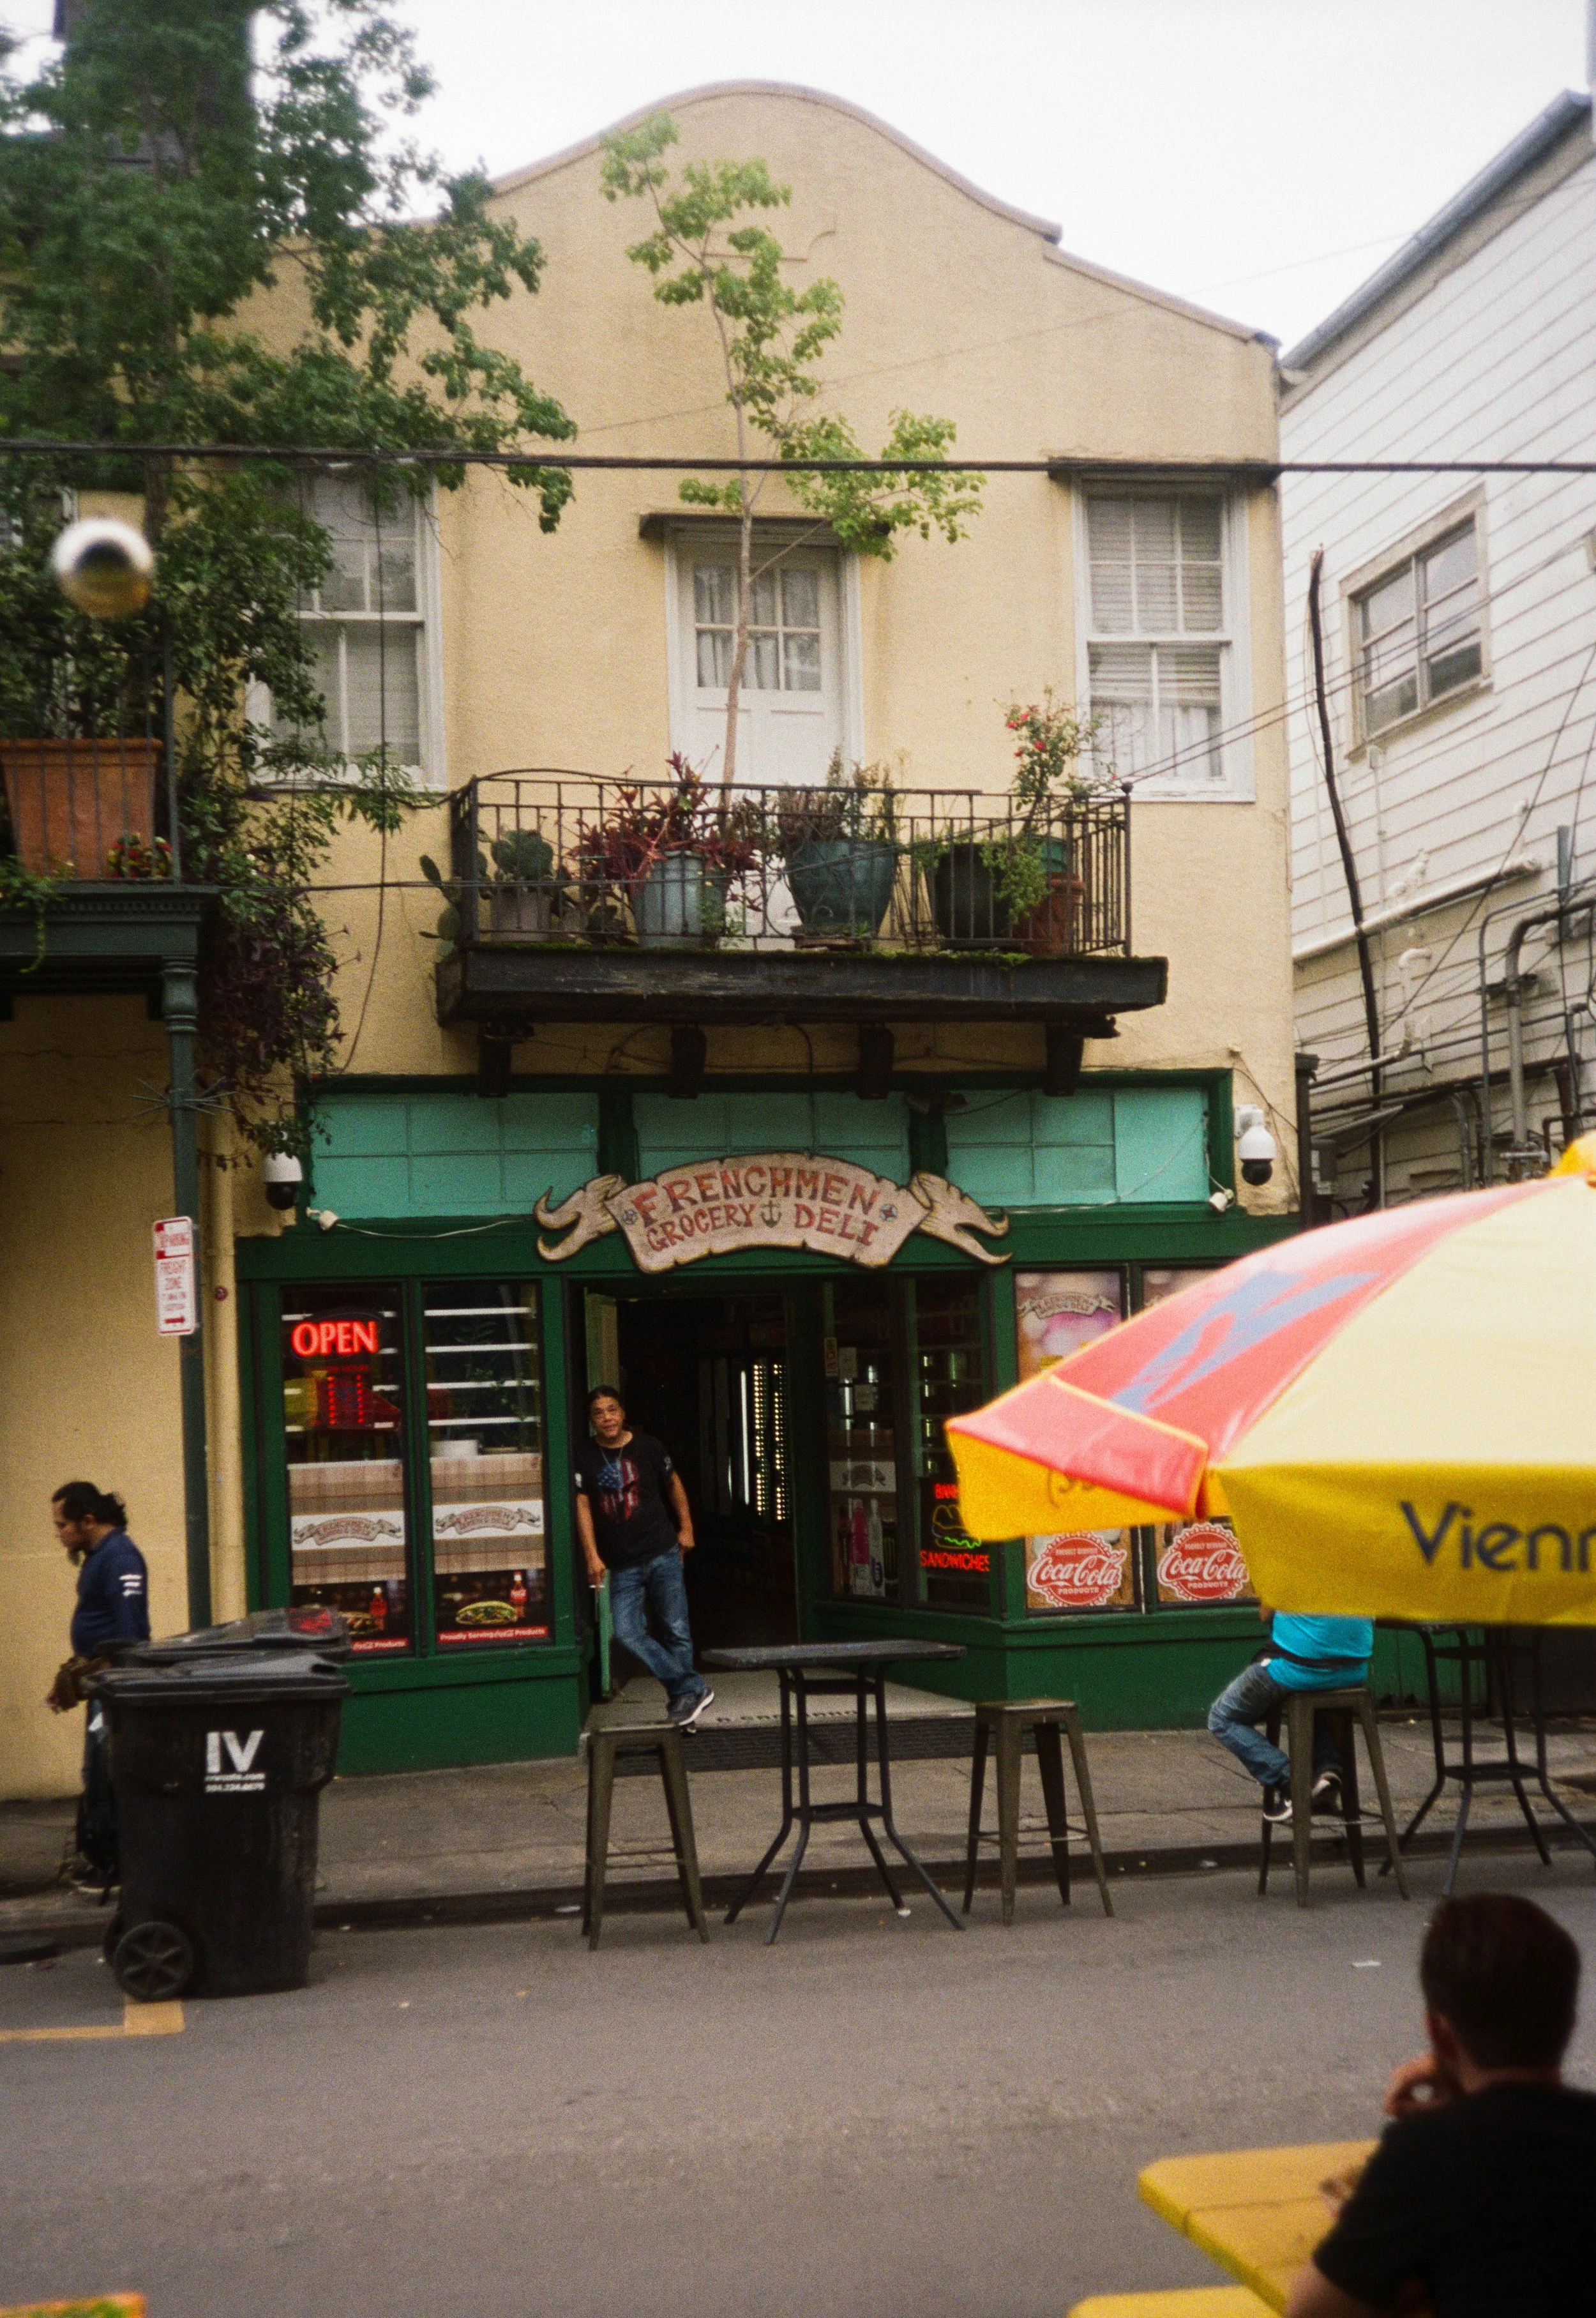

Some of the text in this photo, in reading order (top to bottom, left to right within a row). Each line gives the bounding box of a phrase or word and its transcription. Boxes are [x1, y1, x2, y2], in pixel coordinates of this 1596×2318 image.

[631, 1165, 880, 1228] FRENCHMEN
[645, 1203, 879, 1252] GROCERY DELI
[292, 1320, 379, 1358] OPEN
[919, 1550, 990, 1572] SANDWICHES
[1029, 1550, 1125, 1588] Coca-Cola
[1158, 1548, 1247, 1582] Coca-Cola
[1058, 1586, 1099, 1595] PRODUCTS
[206, 1729, 264, 1773] IV
